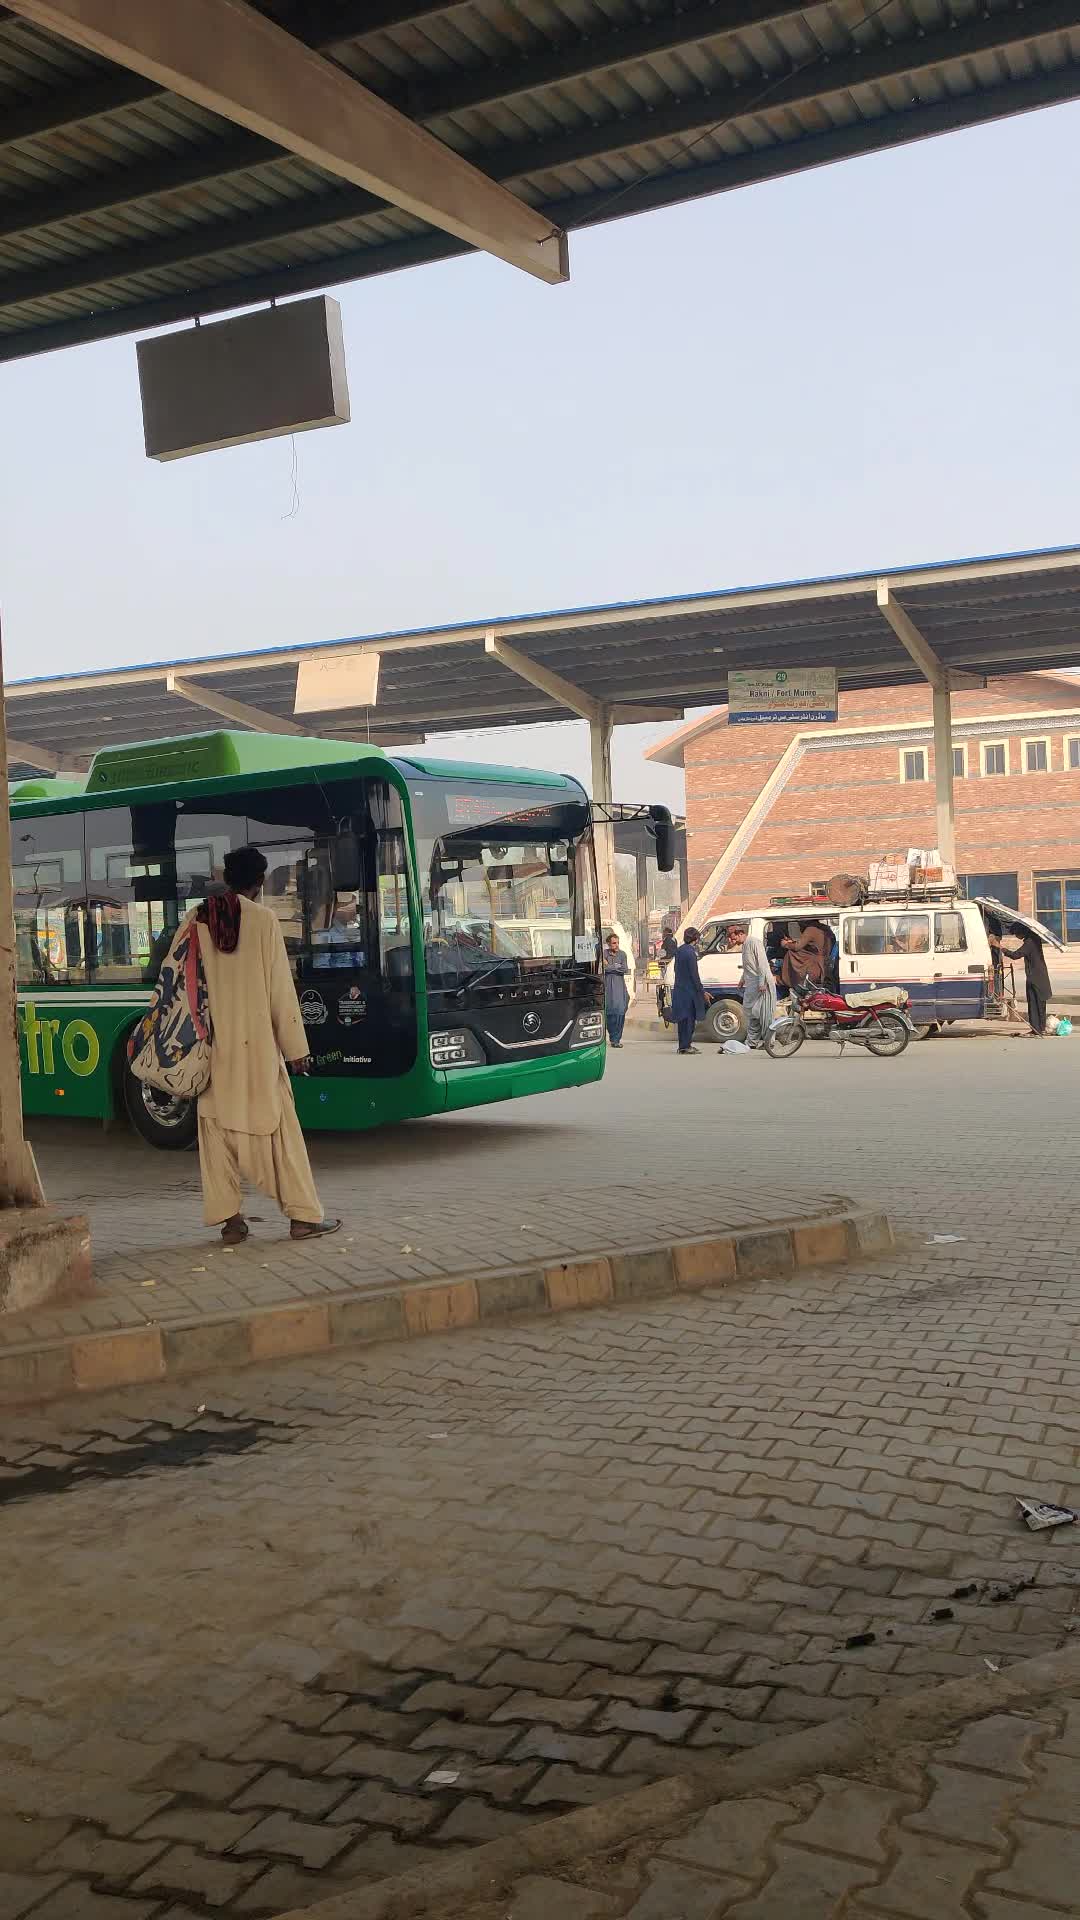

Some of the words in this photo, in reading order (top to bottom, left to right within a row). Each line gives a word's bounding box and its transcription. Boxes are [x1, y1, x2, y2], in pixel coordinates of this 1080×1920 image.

[777, 673, 786, 681] 29
[749, 690, 770, 698] Rakni
[793, 689, 817, 697] Munro
[498, 987, 563, 999] YUTONG
[23, 1001, 100, 1077] tro
[316, 1050, 343, 1065] Green
